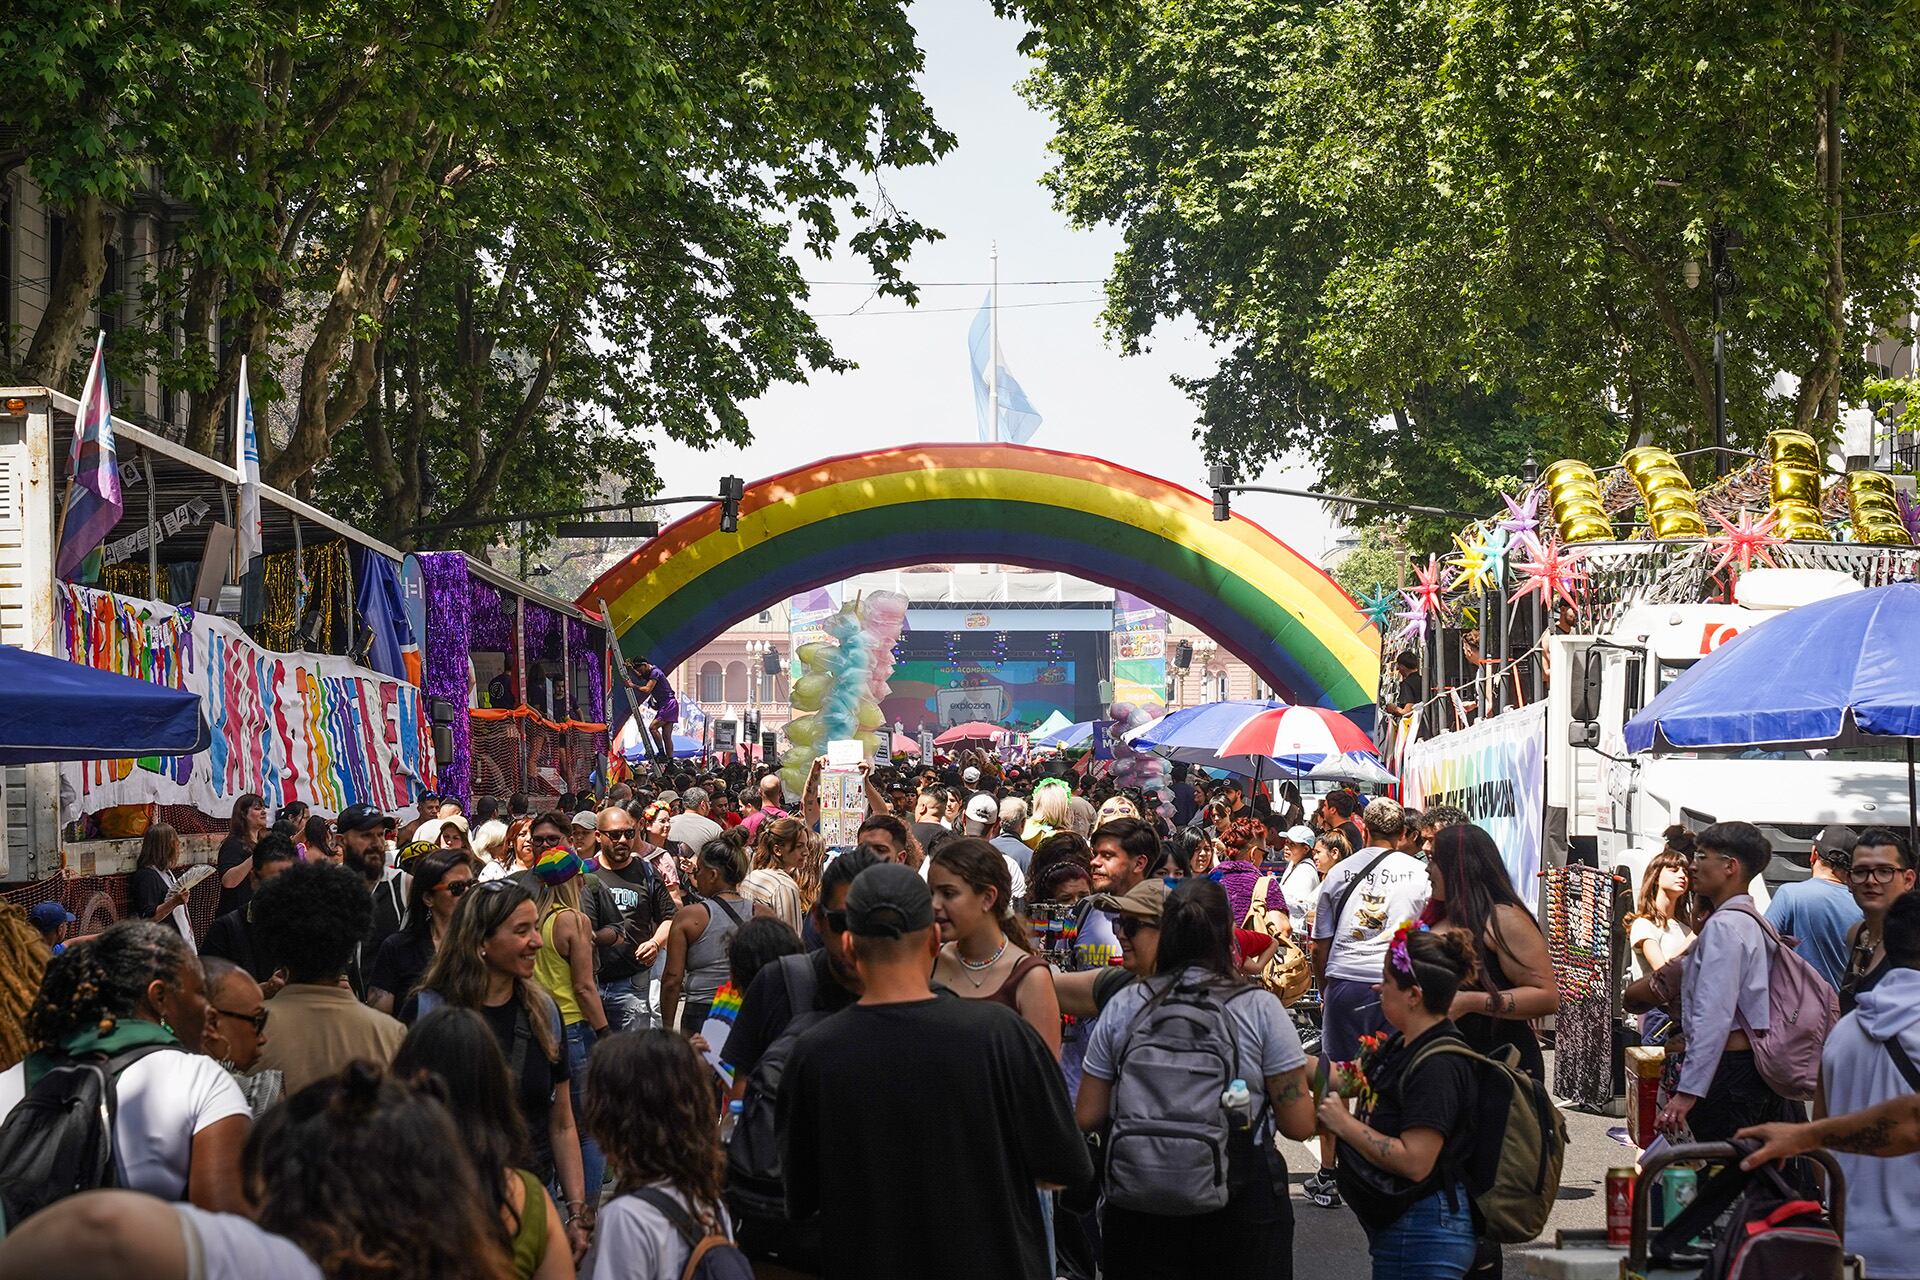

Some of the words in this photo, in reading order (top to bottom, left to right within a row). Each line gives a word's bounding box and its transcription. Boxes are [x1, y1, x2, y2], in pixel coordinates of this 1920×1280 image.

[950, 700, 991, 711] explozion
[1381, 868, 1414, 885] Surf
[609, 887, 639, 908] TON
